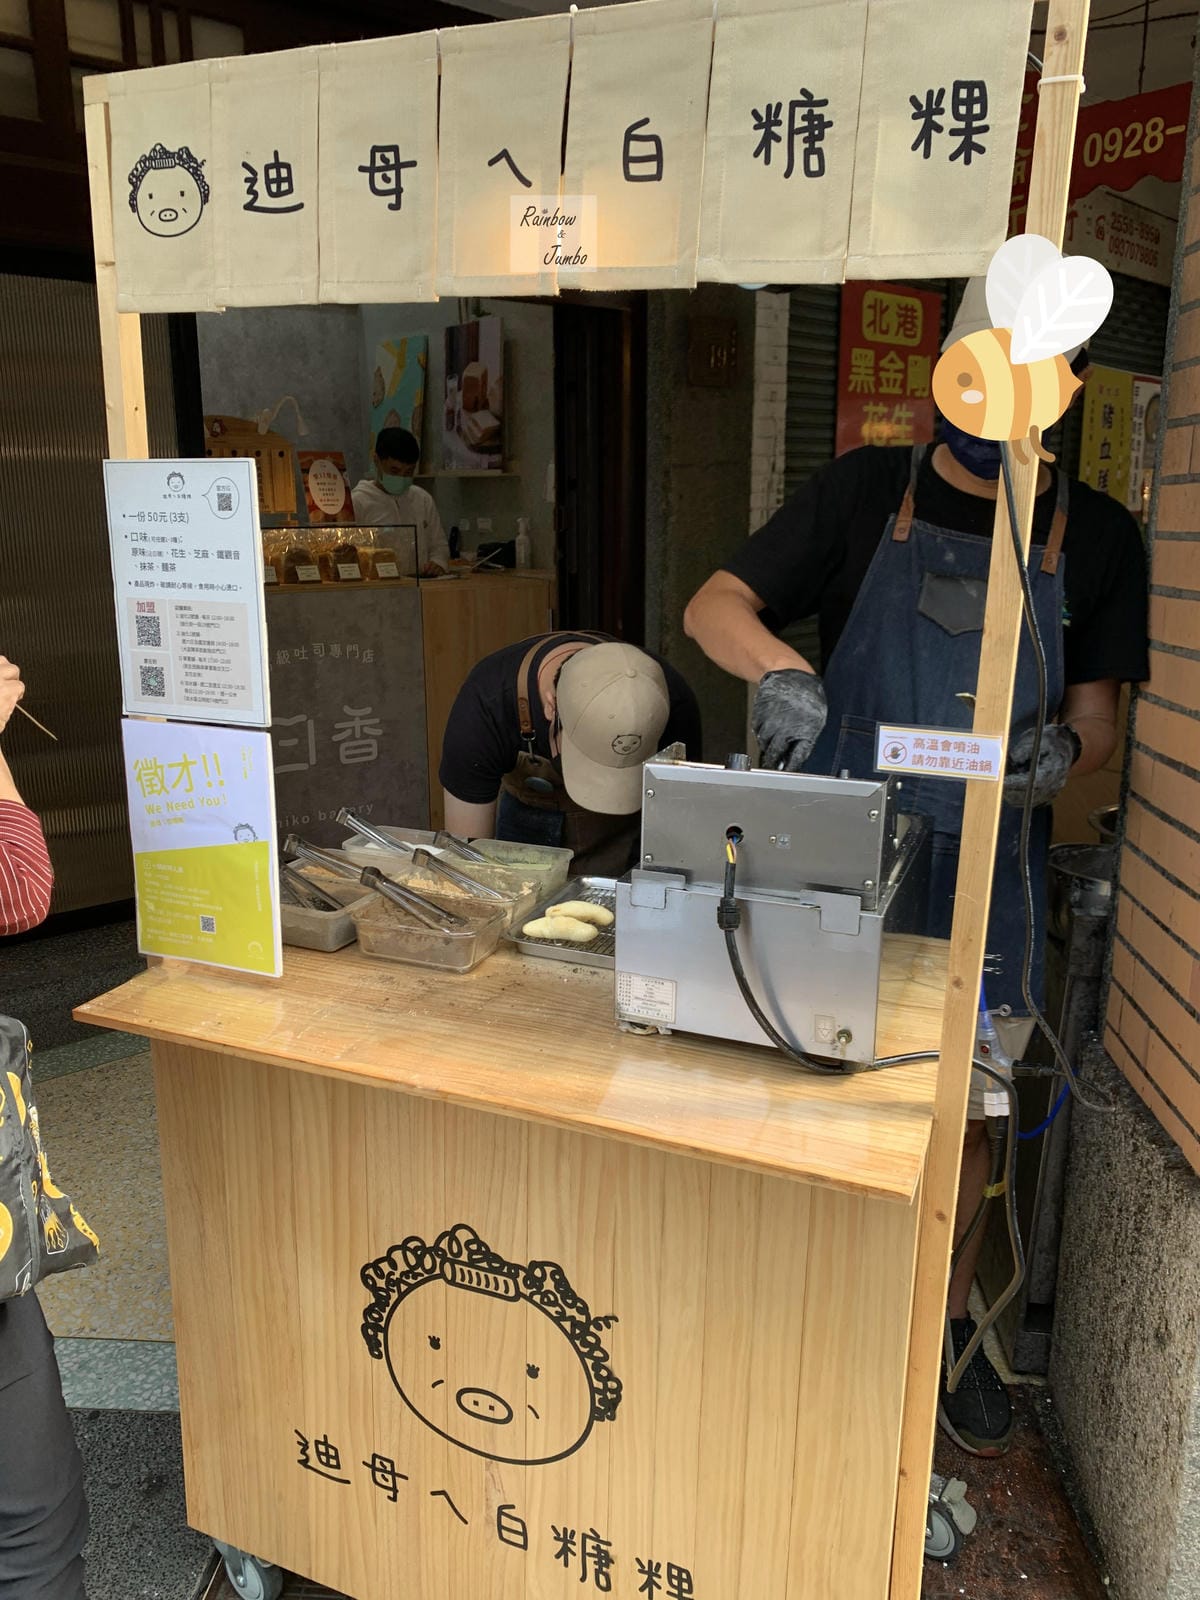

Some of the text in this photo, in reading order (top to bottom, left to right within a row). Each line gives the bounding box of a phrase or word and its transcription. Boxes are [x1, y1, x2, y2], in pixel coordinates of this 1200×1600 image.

[1082, 116, 1187, 168] 0928-
[866, 297, 918, 339] 北港
[136, 601, 156, 614] 加盟
[270, 643, 375, 672] 級吐司專門店
[912, 737, 980, 755] 高溫會噴油
[911, 754, 993, 773] 請勿靠近油鍋
[145, 803, 162, 815] We
[166, 799, 195, 812] Need
[318, 803, 375, 821] baery
